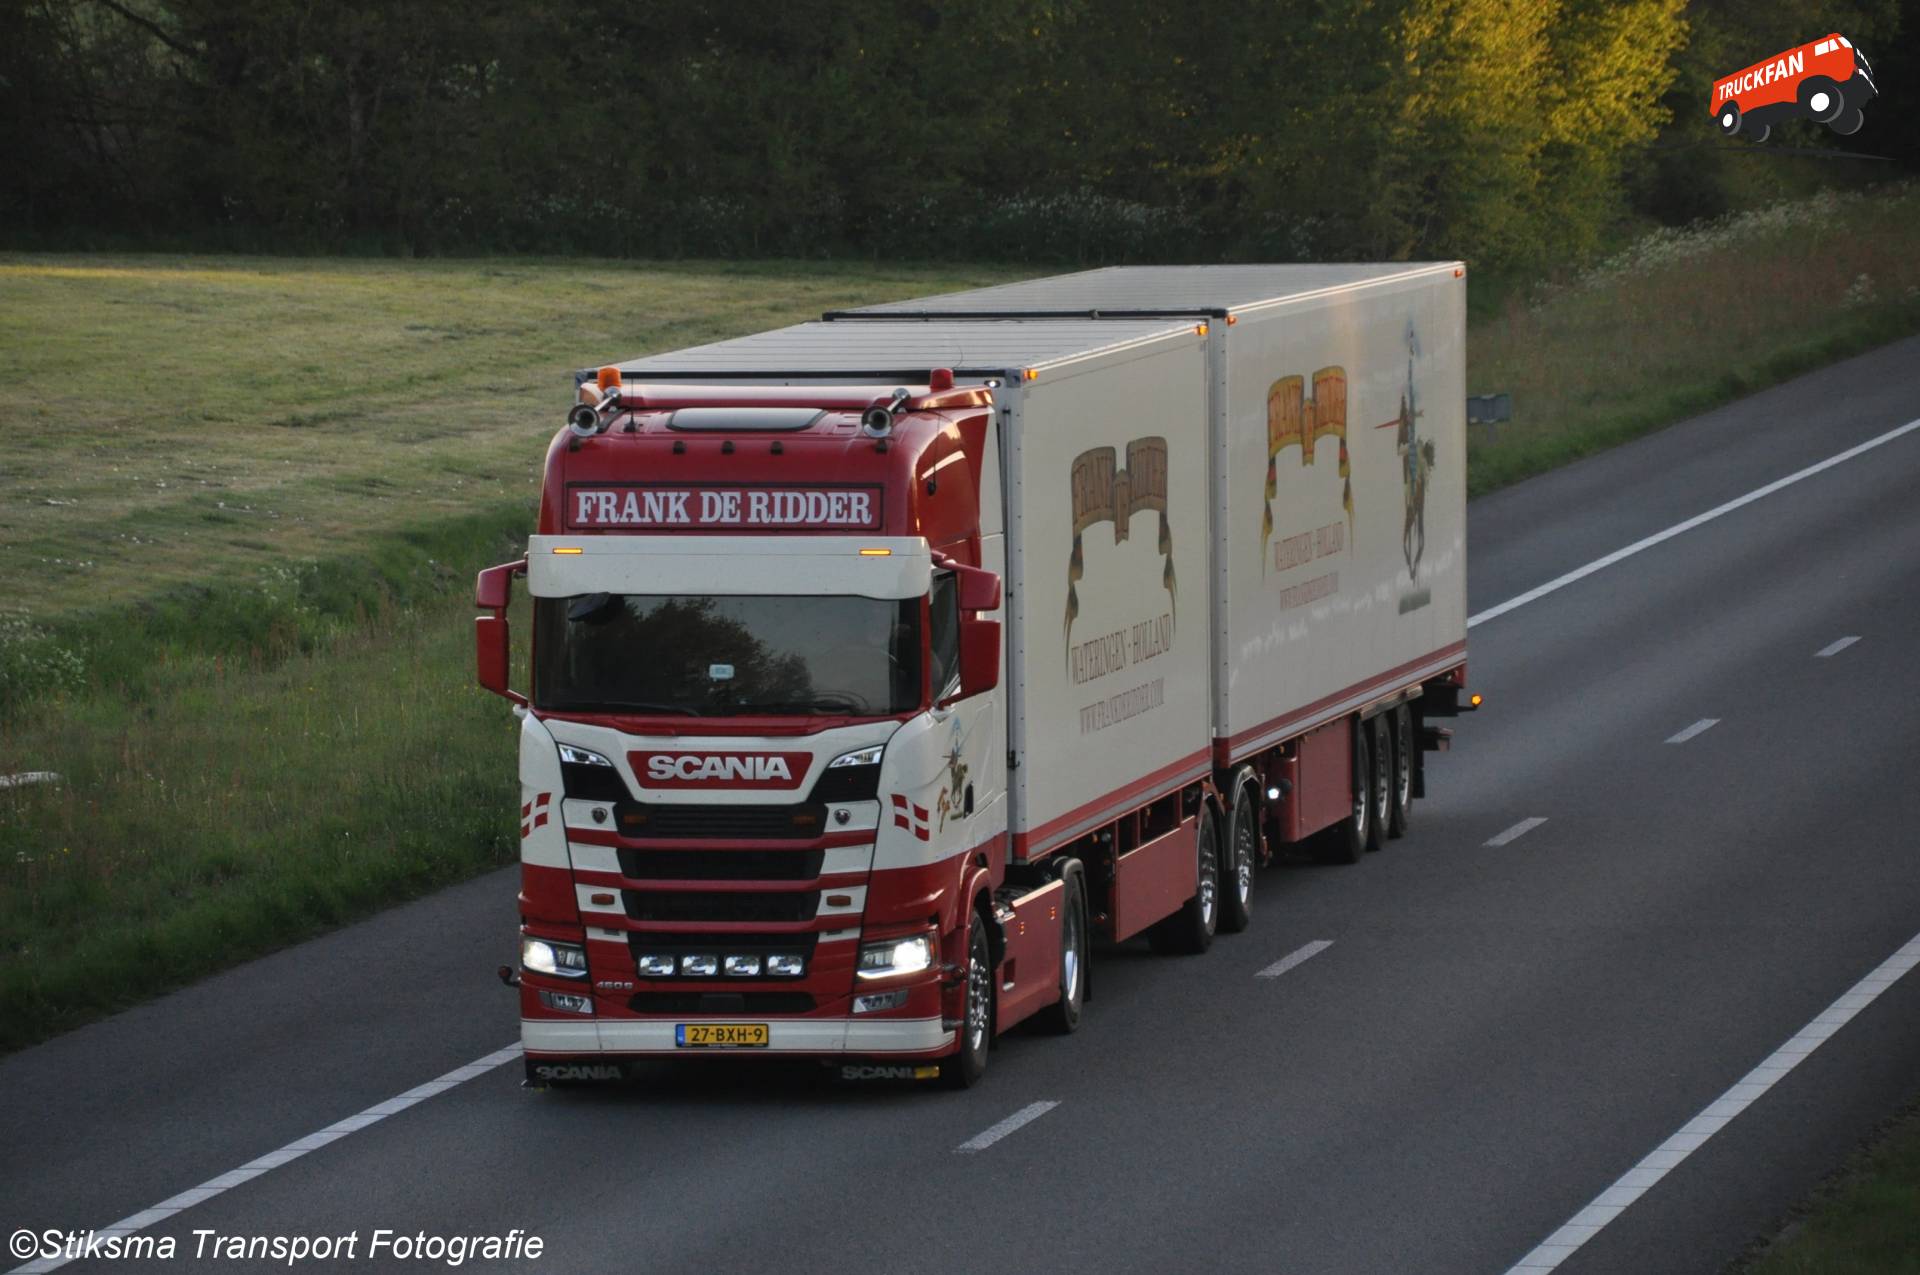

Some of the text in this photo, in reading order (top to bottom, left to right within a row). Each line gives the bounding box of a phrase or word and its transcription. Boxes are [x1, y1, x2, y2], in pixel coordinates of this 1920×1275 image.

[575, 491, 872, 524] FRANK DE RIDDER
[647, 755, 792, 780] SCANIA
[691, 1027, 763, 1042] 27-BXH-9
[536, 1066, 621, 1080] SCANIA
[841, 1066, 922, 1080] SCANI
